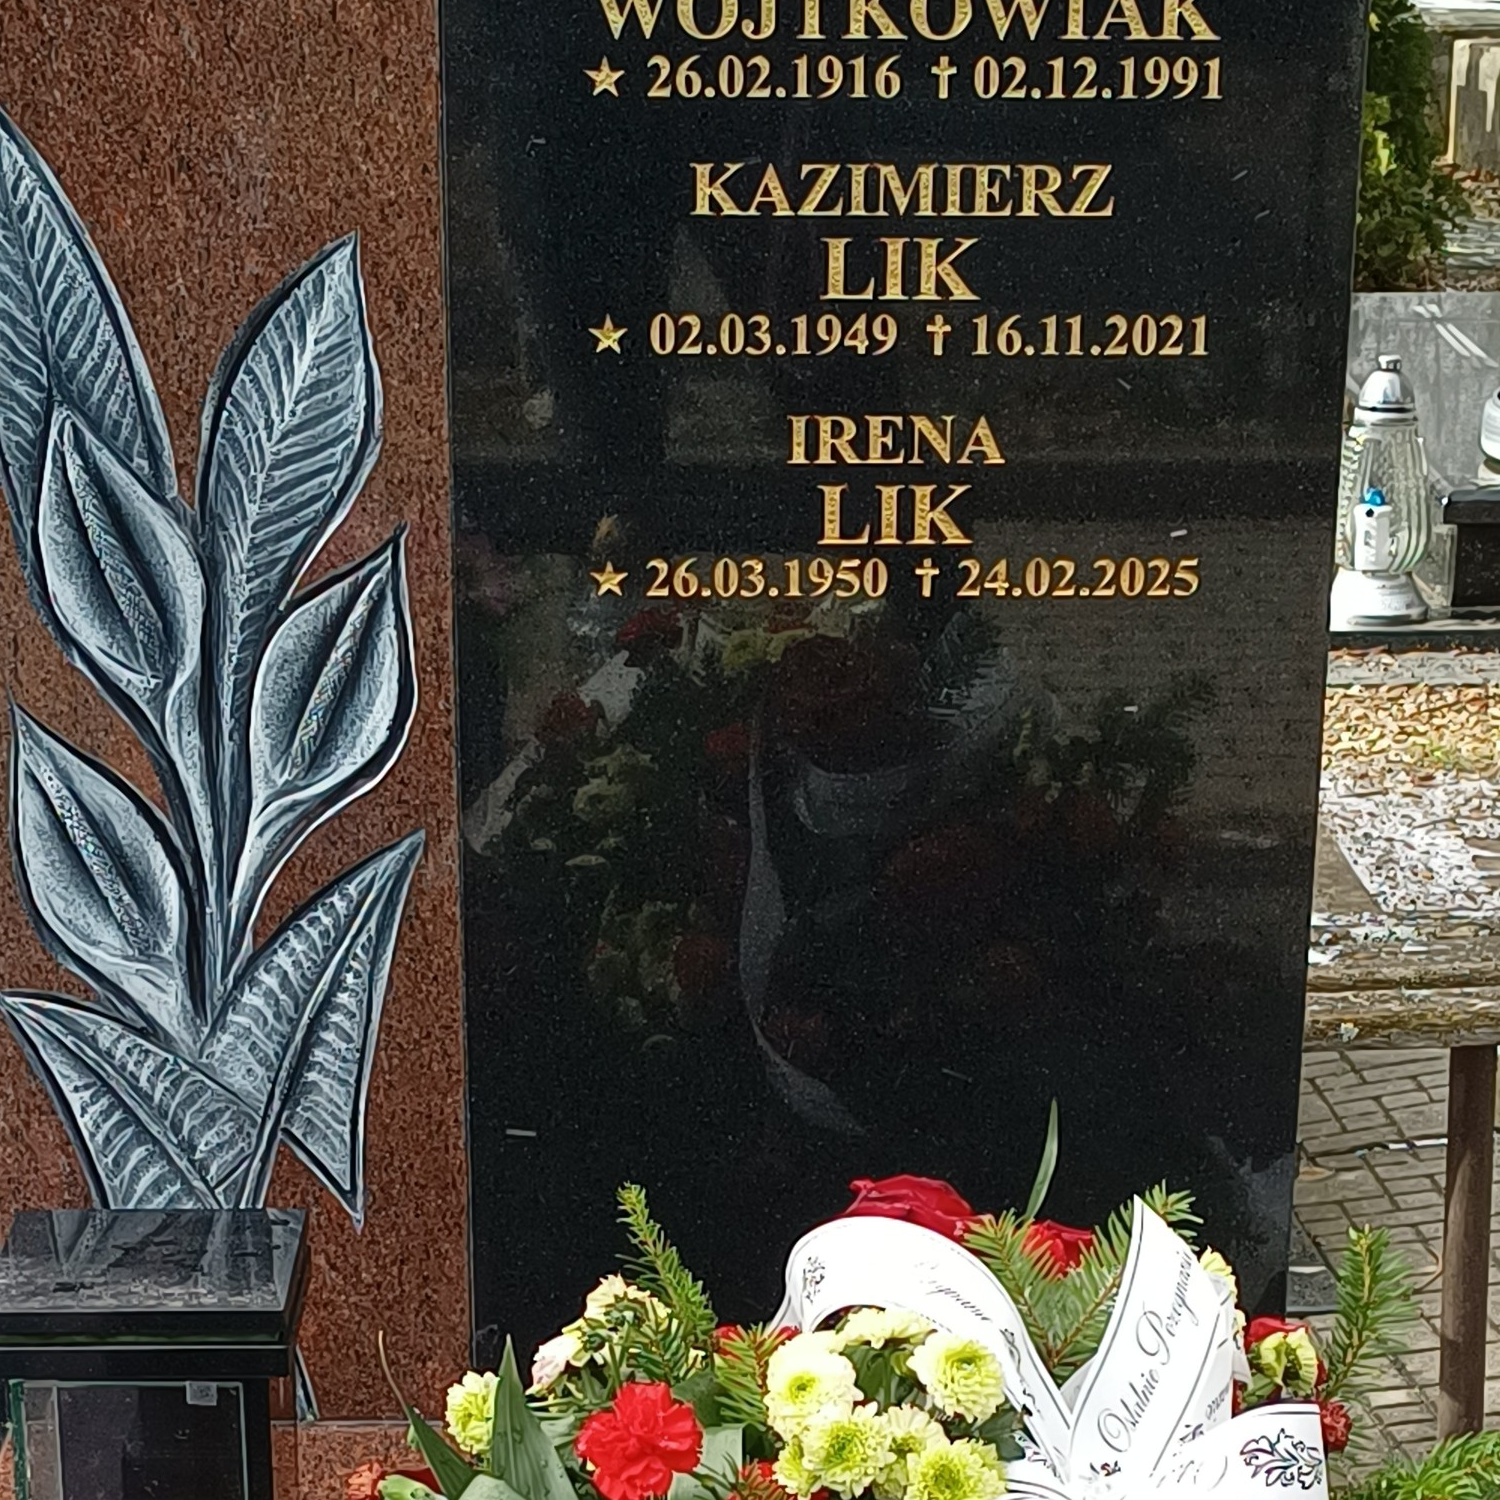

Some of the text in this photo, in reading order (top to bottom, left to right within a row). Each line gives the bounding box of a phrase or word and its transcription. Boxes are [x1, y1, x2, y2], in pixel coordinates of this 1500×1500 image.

[647, 54, 1221, 99] 26.02.1916 02.12.1991
[691, 162, 1115, 217] KAZIMIERZ
[819, 237, 978, 301] LIK
[648, 312, 1207, 356] 02.03.1949 16.11.2021
[786, 414, 1007, 465] IRENA
[817, 483, 975, 545] LIK
[644, 556, 1201, 598] 26.03.1950 24.02.2025
